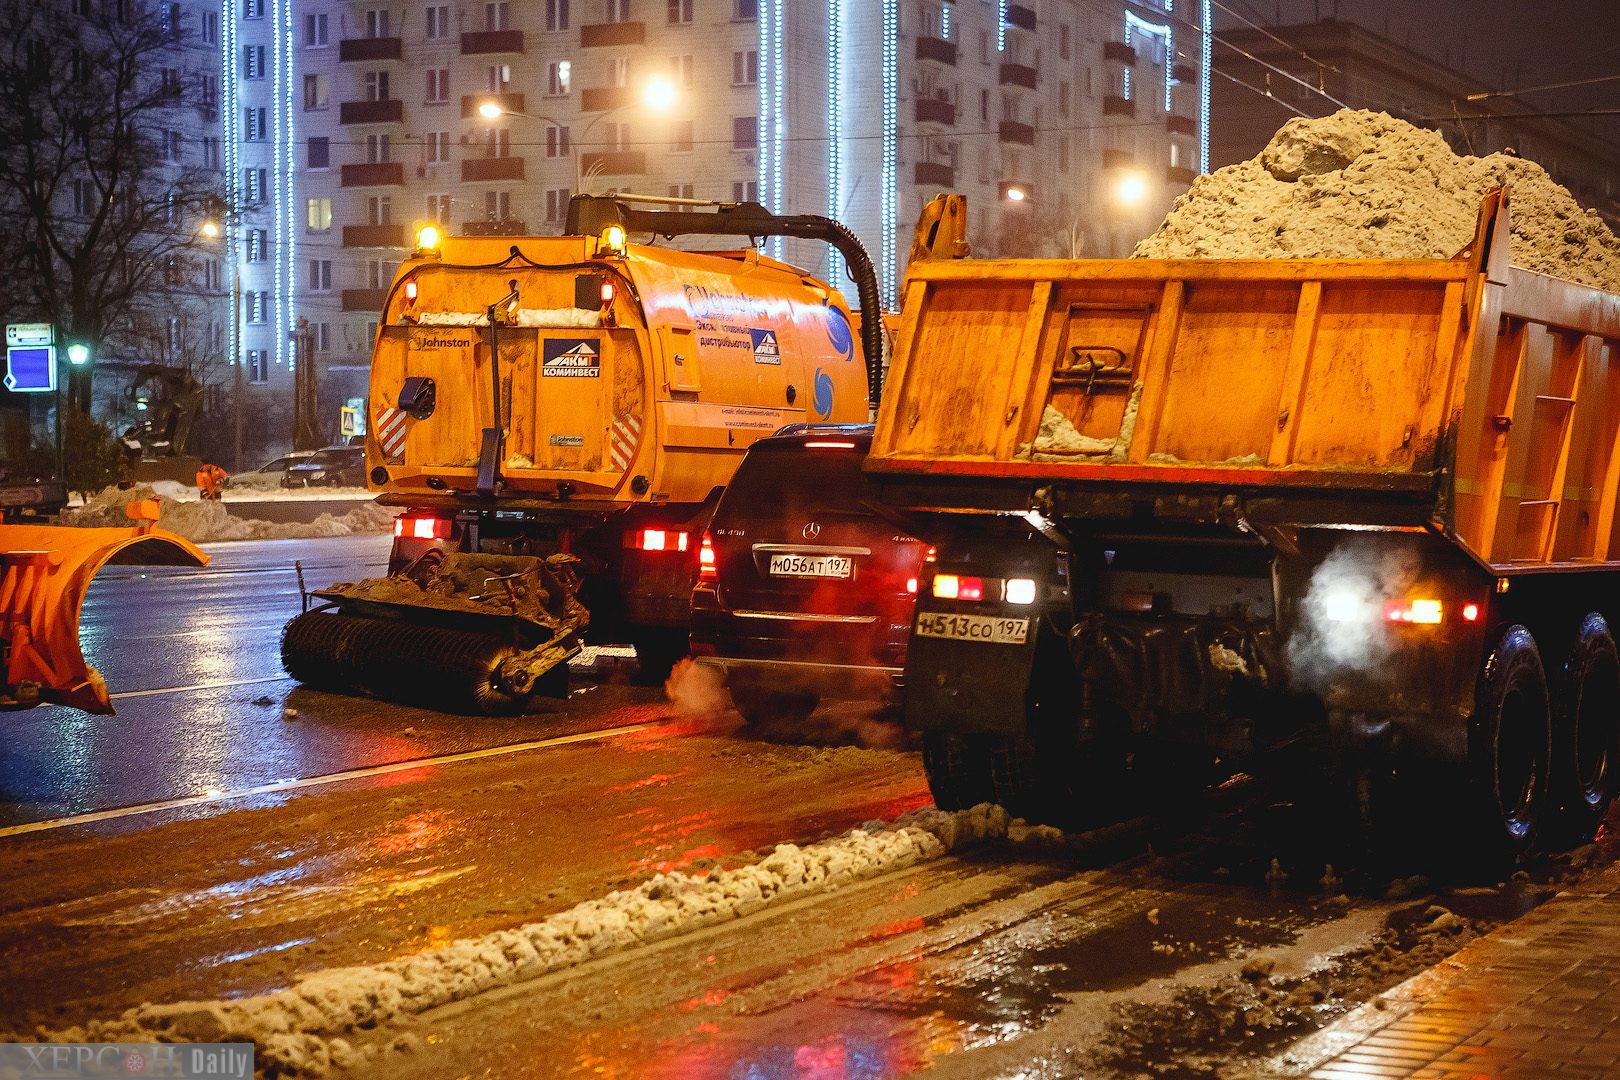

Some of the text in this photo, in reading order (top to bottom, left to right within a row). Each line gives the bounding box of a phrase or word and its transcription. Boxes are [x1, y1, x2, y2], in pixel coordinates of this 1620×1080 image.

[422, 336, 470, 347] Johnston
[543, 368, 599, 377] КОМИНВЕСТ
[772, 557, 848, 574] М056АТ 197
[919, 616, 993, 638] Н513СО
[997, 620, 1024, 636] 197
